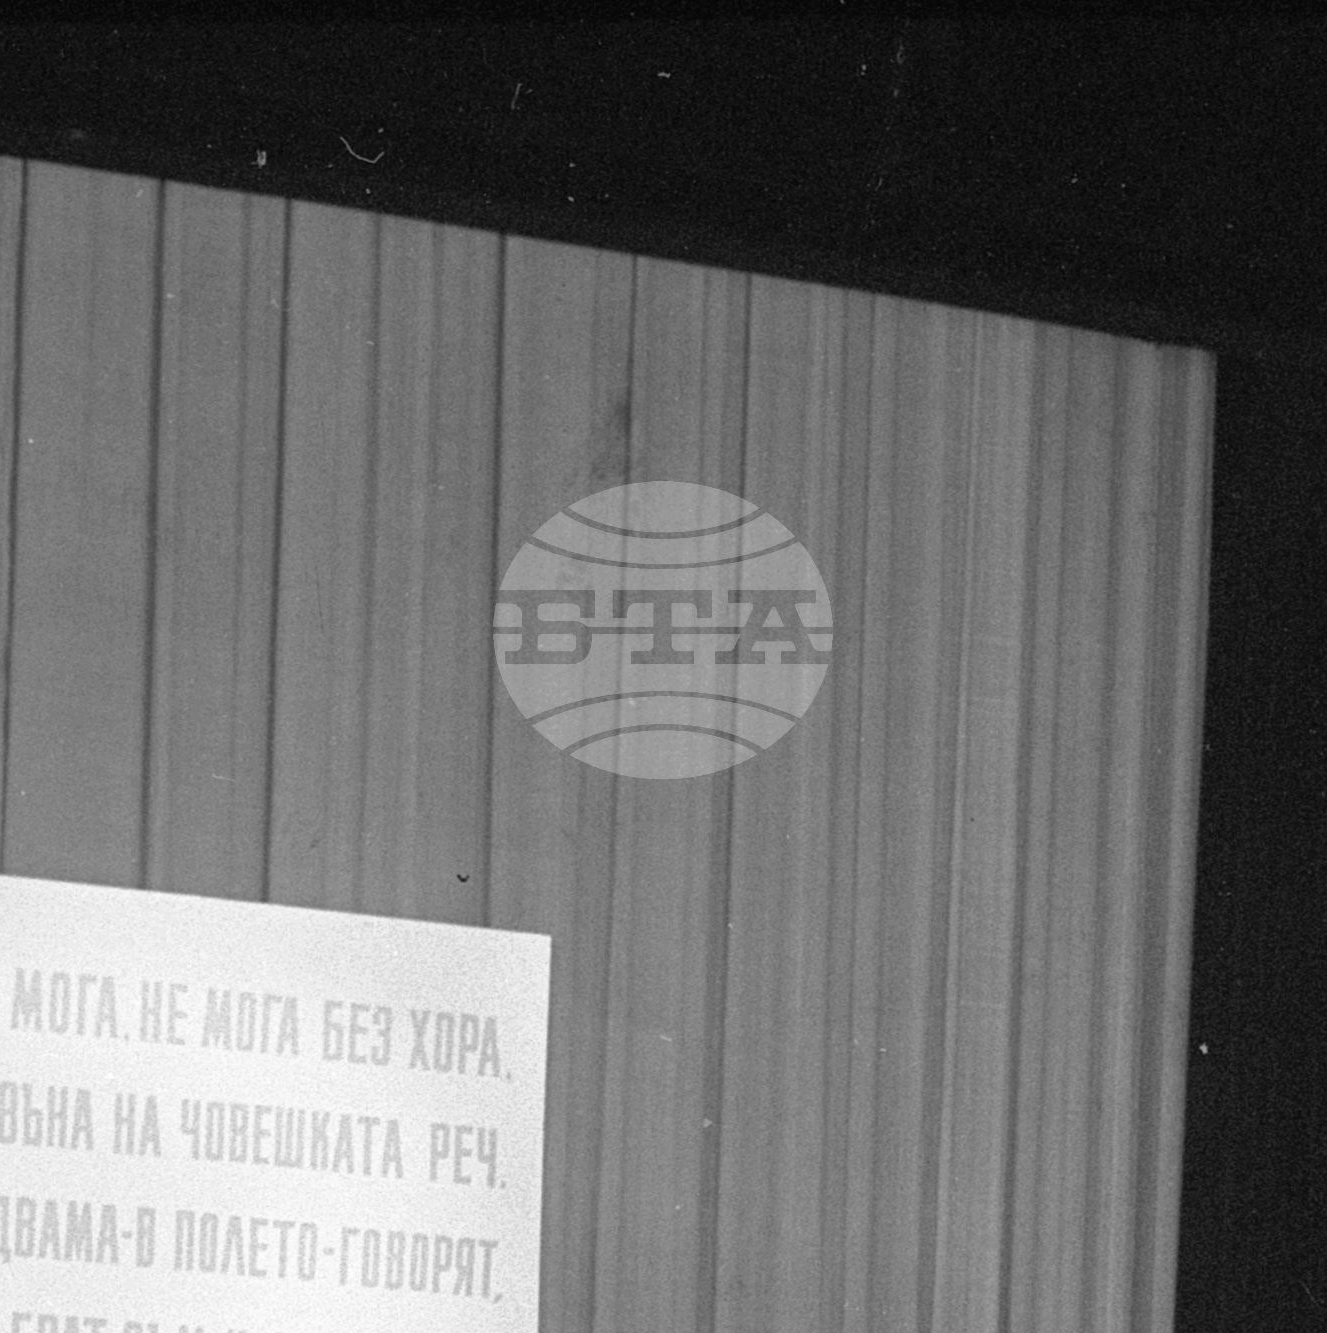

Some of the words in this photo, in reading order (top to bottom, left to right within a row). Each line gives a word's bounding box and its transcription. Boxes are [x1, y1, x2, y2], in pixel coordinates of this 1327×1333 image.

[139, 980, 189, 1046] НЕ
[200, 987, 300, 1056] МОГА
[322, 999, 394, 1066] БЕЗ
[112, 1092, 163, 1157] НА
[179, 1098, 404, 1180] ЧОВЕШКАТА
